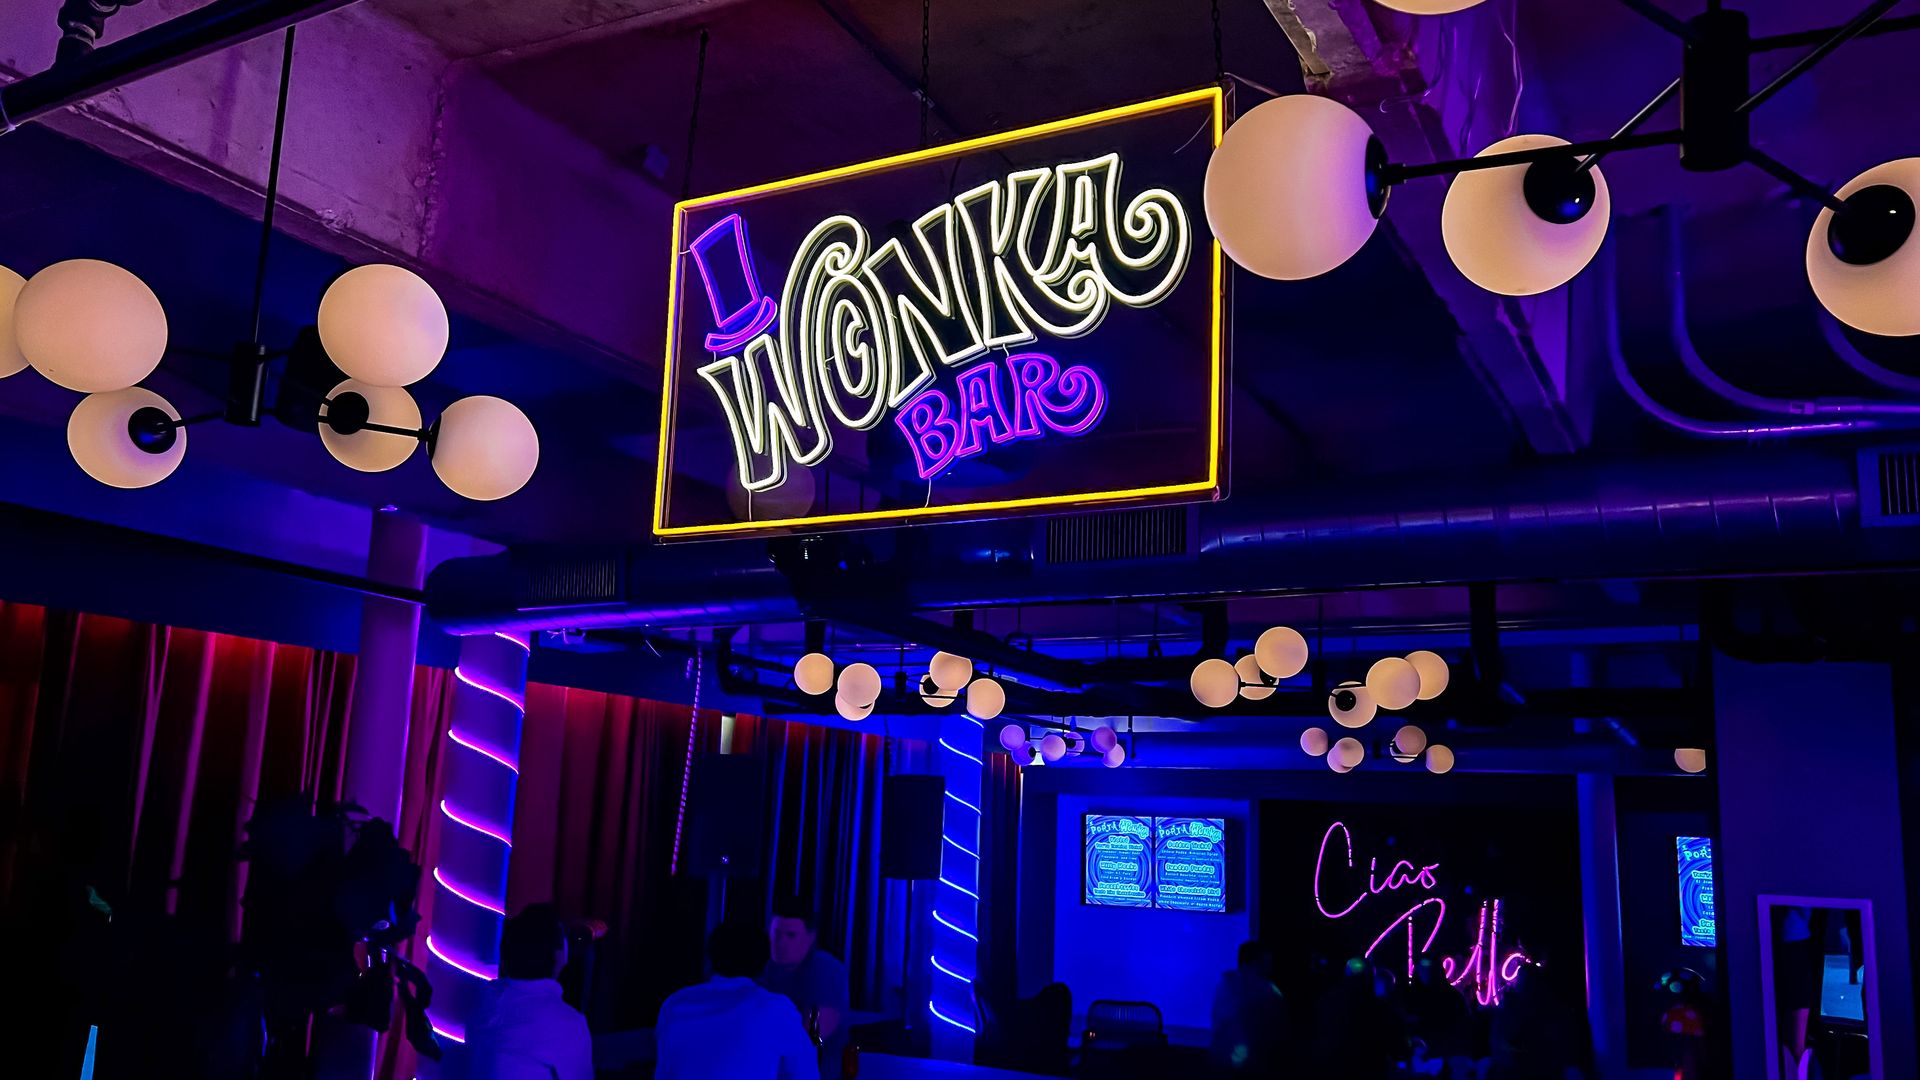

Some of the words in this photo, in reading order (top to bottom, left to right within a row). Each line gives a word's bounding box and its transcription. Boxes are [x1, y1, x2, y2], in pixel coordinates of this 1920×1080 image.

[697, 153, 1191, 490] WONKA
[894, 352, 1108, 479] BAR
[1314, 821, 1440, 918] Ciao
